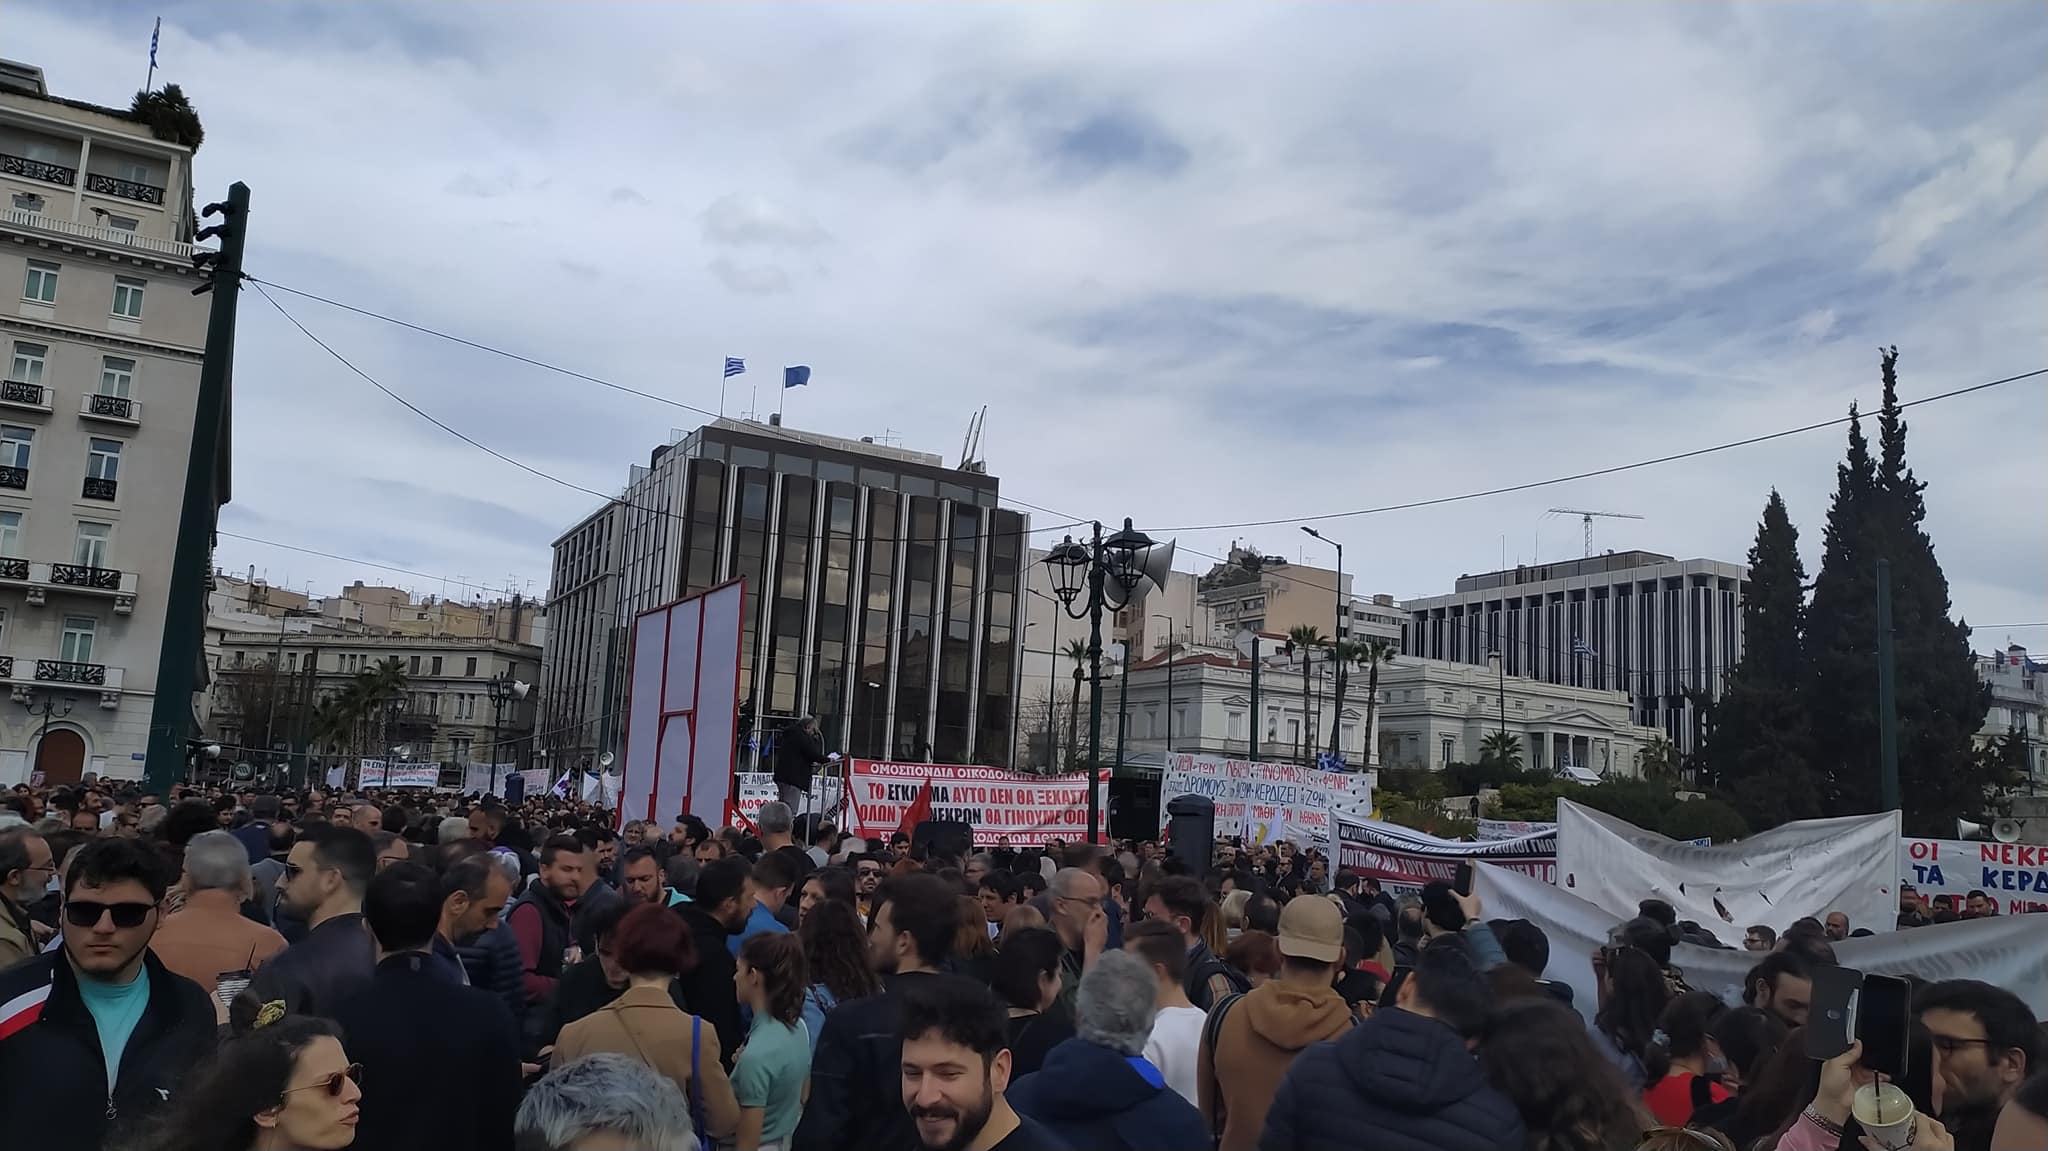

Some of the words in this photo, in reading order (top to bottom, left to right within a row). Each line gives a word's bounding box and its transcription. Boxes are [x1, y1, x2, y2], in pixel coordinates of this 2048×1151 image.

[870, 763, 954, 778] ΟΜΟΣΠΟΝΔΙΑ
[868, 782, 885, 800] ΤΟ
[888, 783, 949, 803] ΕΓΚΛΜΑ
[952, 786, 986, 804] ΑΥΤΟ
[990, 788, 1013, 804] ΔΕΝ
[1016, 788, 1035, 805] ΘΑ
[1037, 790, 1089, 805] ΞΕΧΑΣΤ
[1184, 774, 1228, 798] ΔΡΟΜΟΥΣ
[860, 804, 896, 822] ΟΛΩΝ
[985, 808, 1002, 825] ΘΑ
[1005, 808, 1062, 826] ΓΙΝΟΥΜΕ
[1064, 809, 1105, 826] ΦΩΗ
[1909, 842, 1939, 861] ΟΙ
[1912, 863, 1945, 886] ΤΑ
